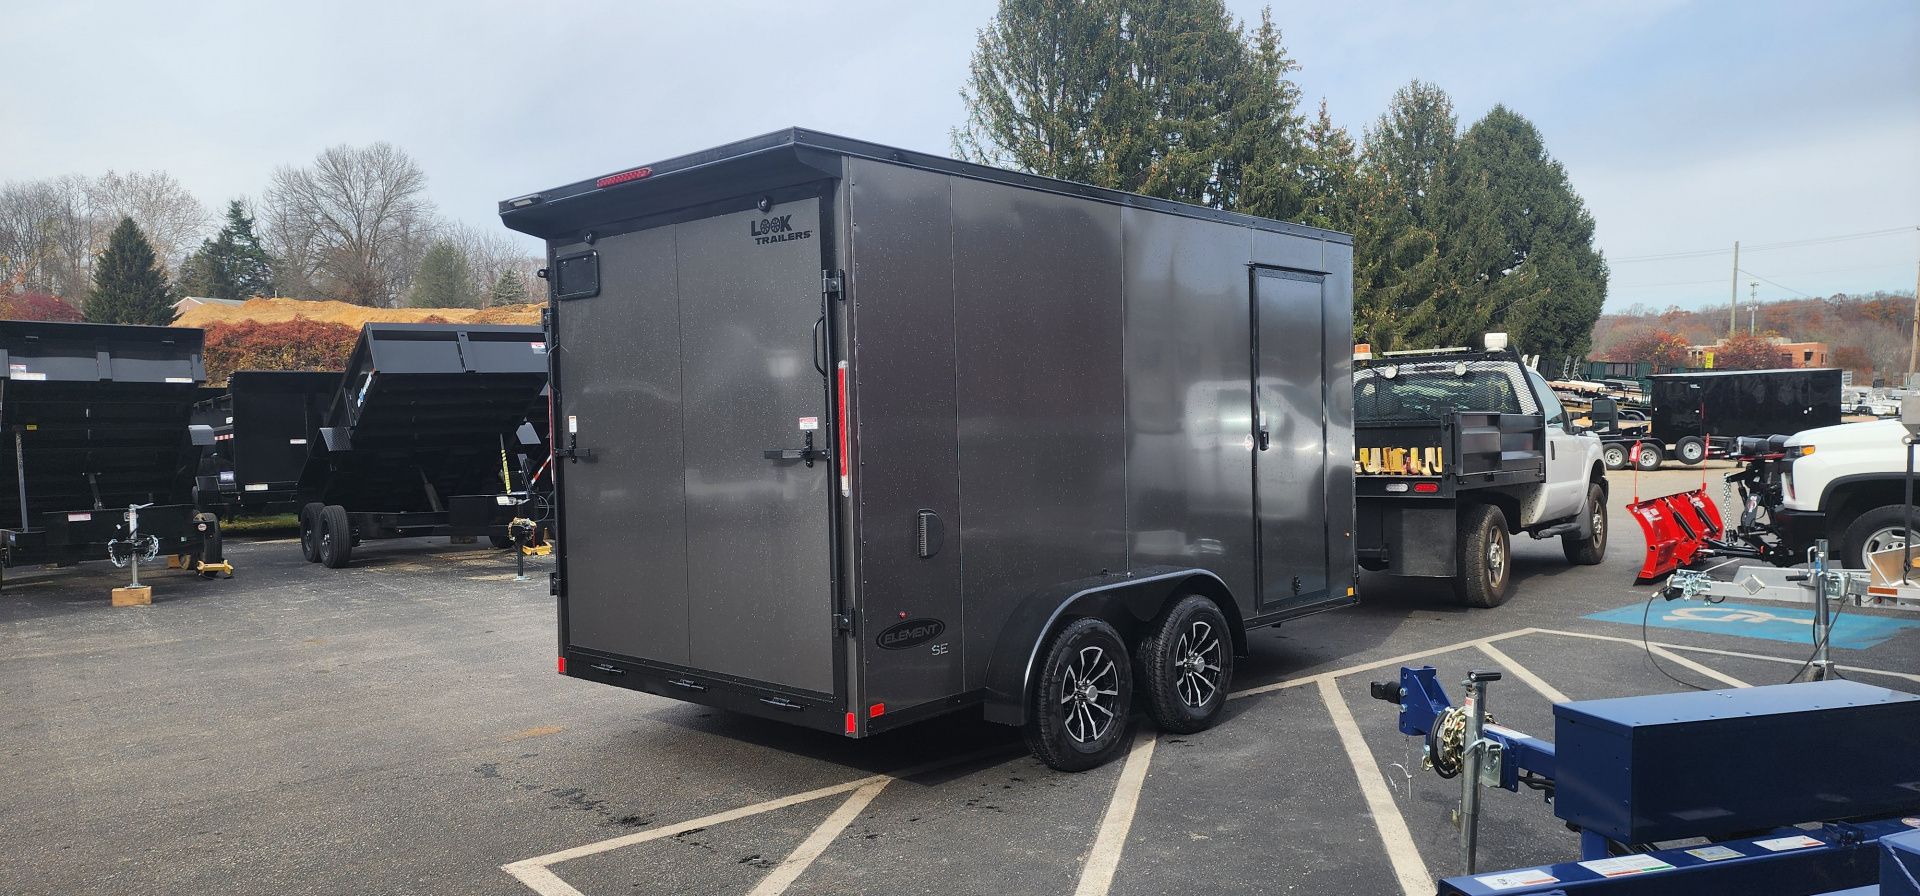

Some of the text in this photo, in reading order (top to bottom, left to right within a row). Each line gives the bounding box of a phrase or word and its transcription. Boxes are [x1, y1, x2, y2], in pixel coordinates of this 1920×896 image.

[751, 215, 792, 236] LOOK
[755, 230, 812, 245] TRAILERS
[884, 624, 938, 644] ELEMENT
[931, 643, 949, 656] SE
